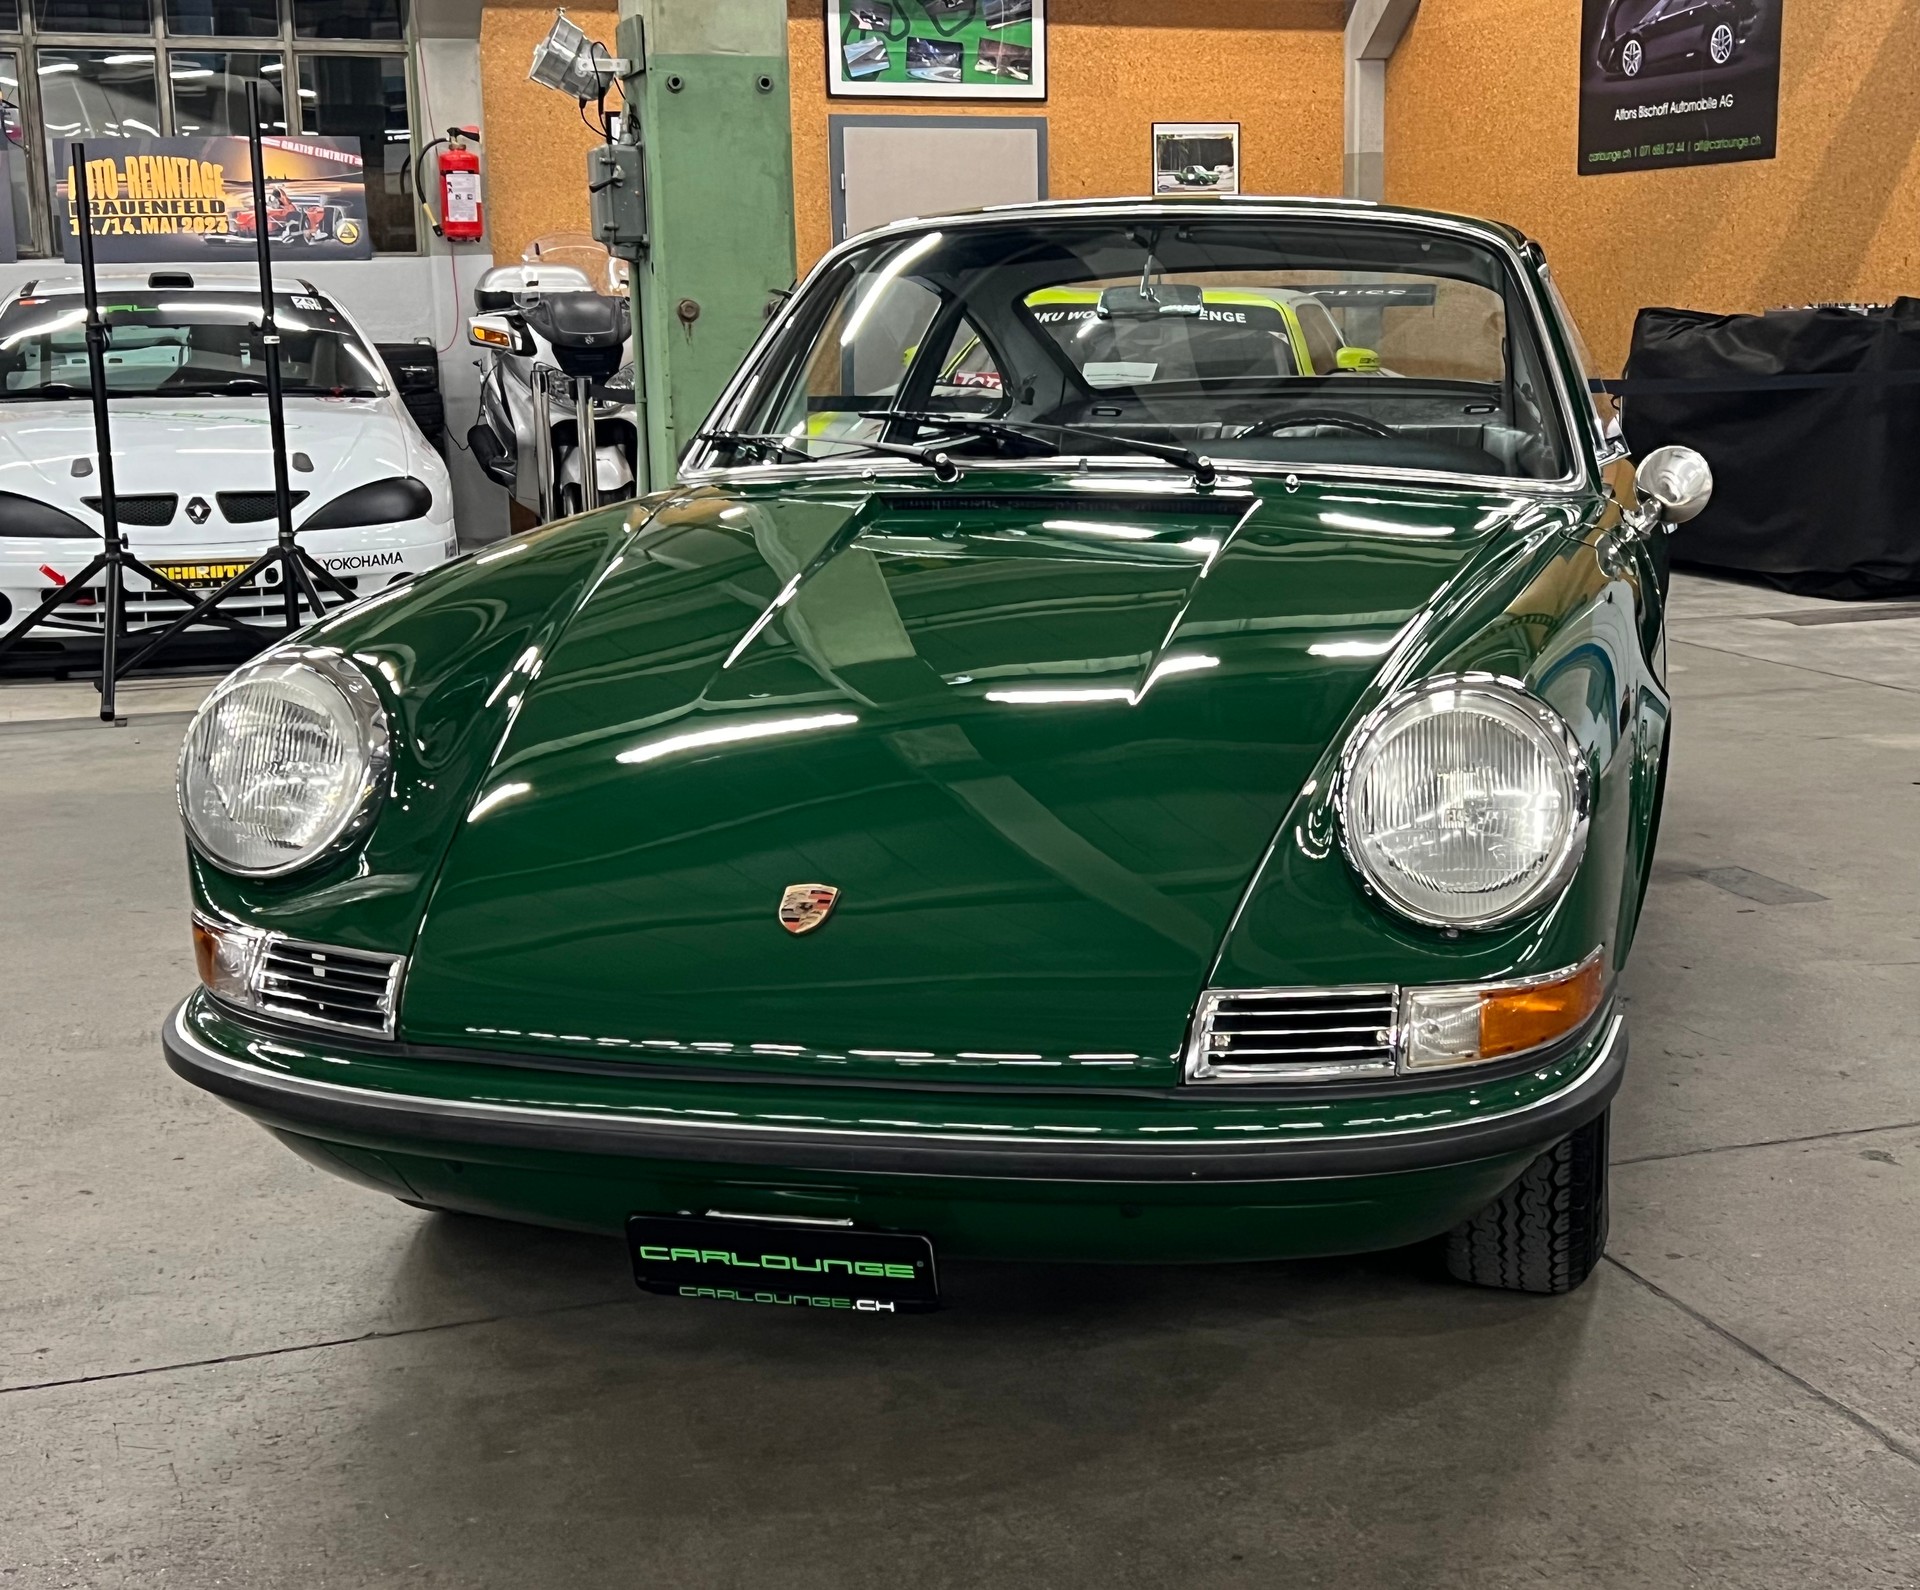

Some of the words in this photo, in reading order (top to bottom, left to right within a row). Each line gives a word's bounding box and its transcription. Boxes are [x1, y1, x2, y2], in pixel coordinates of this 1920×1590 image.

[1614, 108, 1637, 121] Alfons
[1638, 102, 1669, 118] Bischoff
[1669, 97, 1718, 114] Automobile
[1719, 93, 1734, 108] AG
[181, 216, 228, 234] 2023
[1199, 308, 1247, 324] ENGE
[322, 551, 404, 572] YOKOHAMA
[639, 1246, 915, 1279] CARLOUNGE
[678, 1286, 895, 1313] CARLOUNGE.CH
